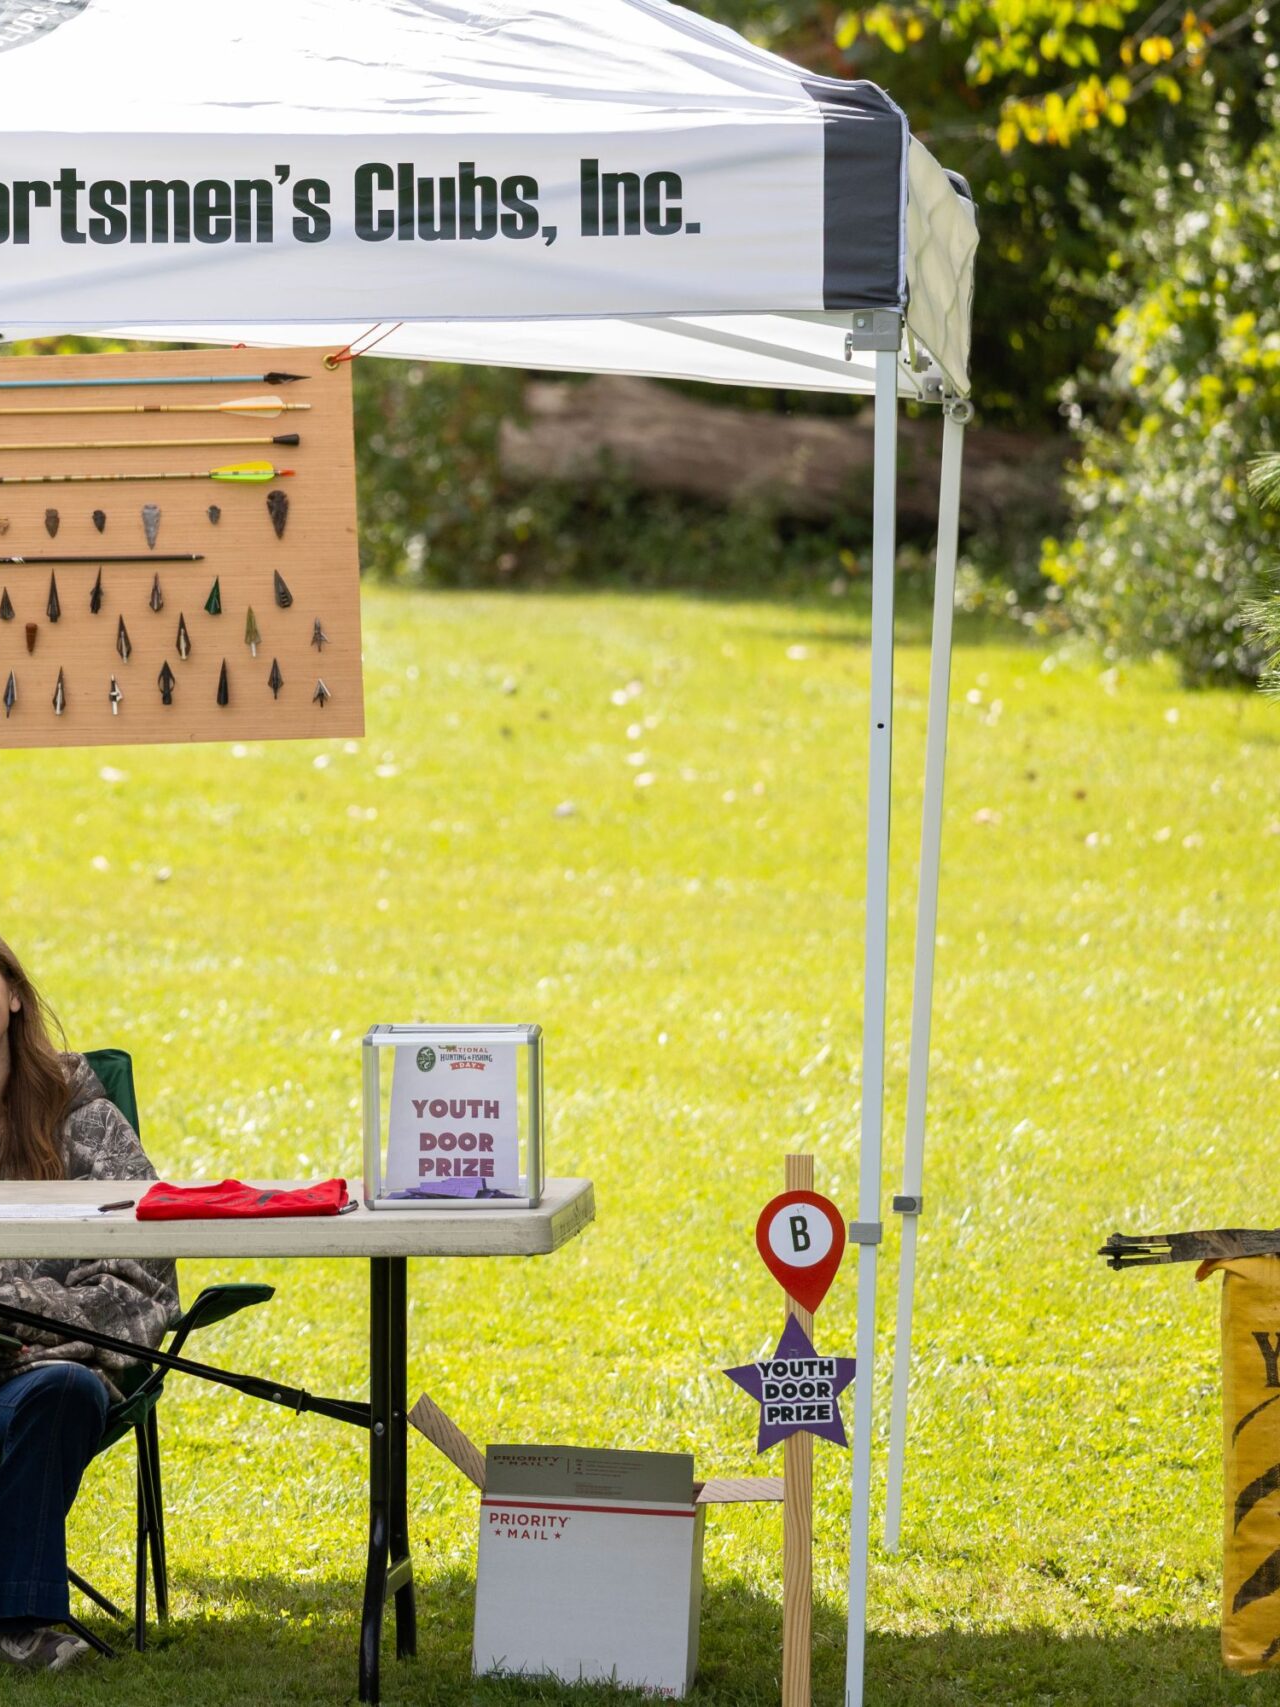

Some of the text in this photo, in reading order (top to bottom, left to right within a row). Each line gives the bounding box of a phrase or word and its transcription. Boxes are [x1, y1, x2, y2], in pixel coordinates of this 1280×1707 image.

[354, 161, 558, 248] Clubs,
[579, 158, 702, 237] Inc.
[440, 1054, 467, 1062] HUNTING
[412, 1099, 500, 1119] YOUTH
[420, 1132, 494, 1152] DOOR
[419, 1158, 495, 1177] PRIZE
[789, 1215, 811, 1252] B
[758, 1359, 835, 1378] YOUTH
[765, 1381, 831, 1400] DOOR
[767, 1404, 831, 1423] PRIZE
[489, 1512, 569, 1528] PRIORITY
[507, 1528, 549, 1540] MAIL
